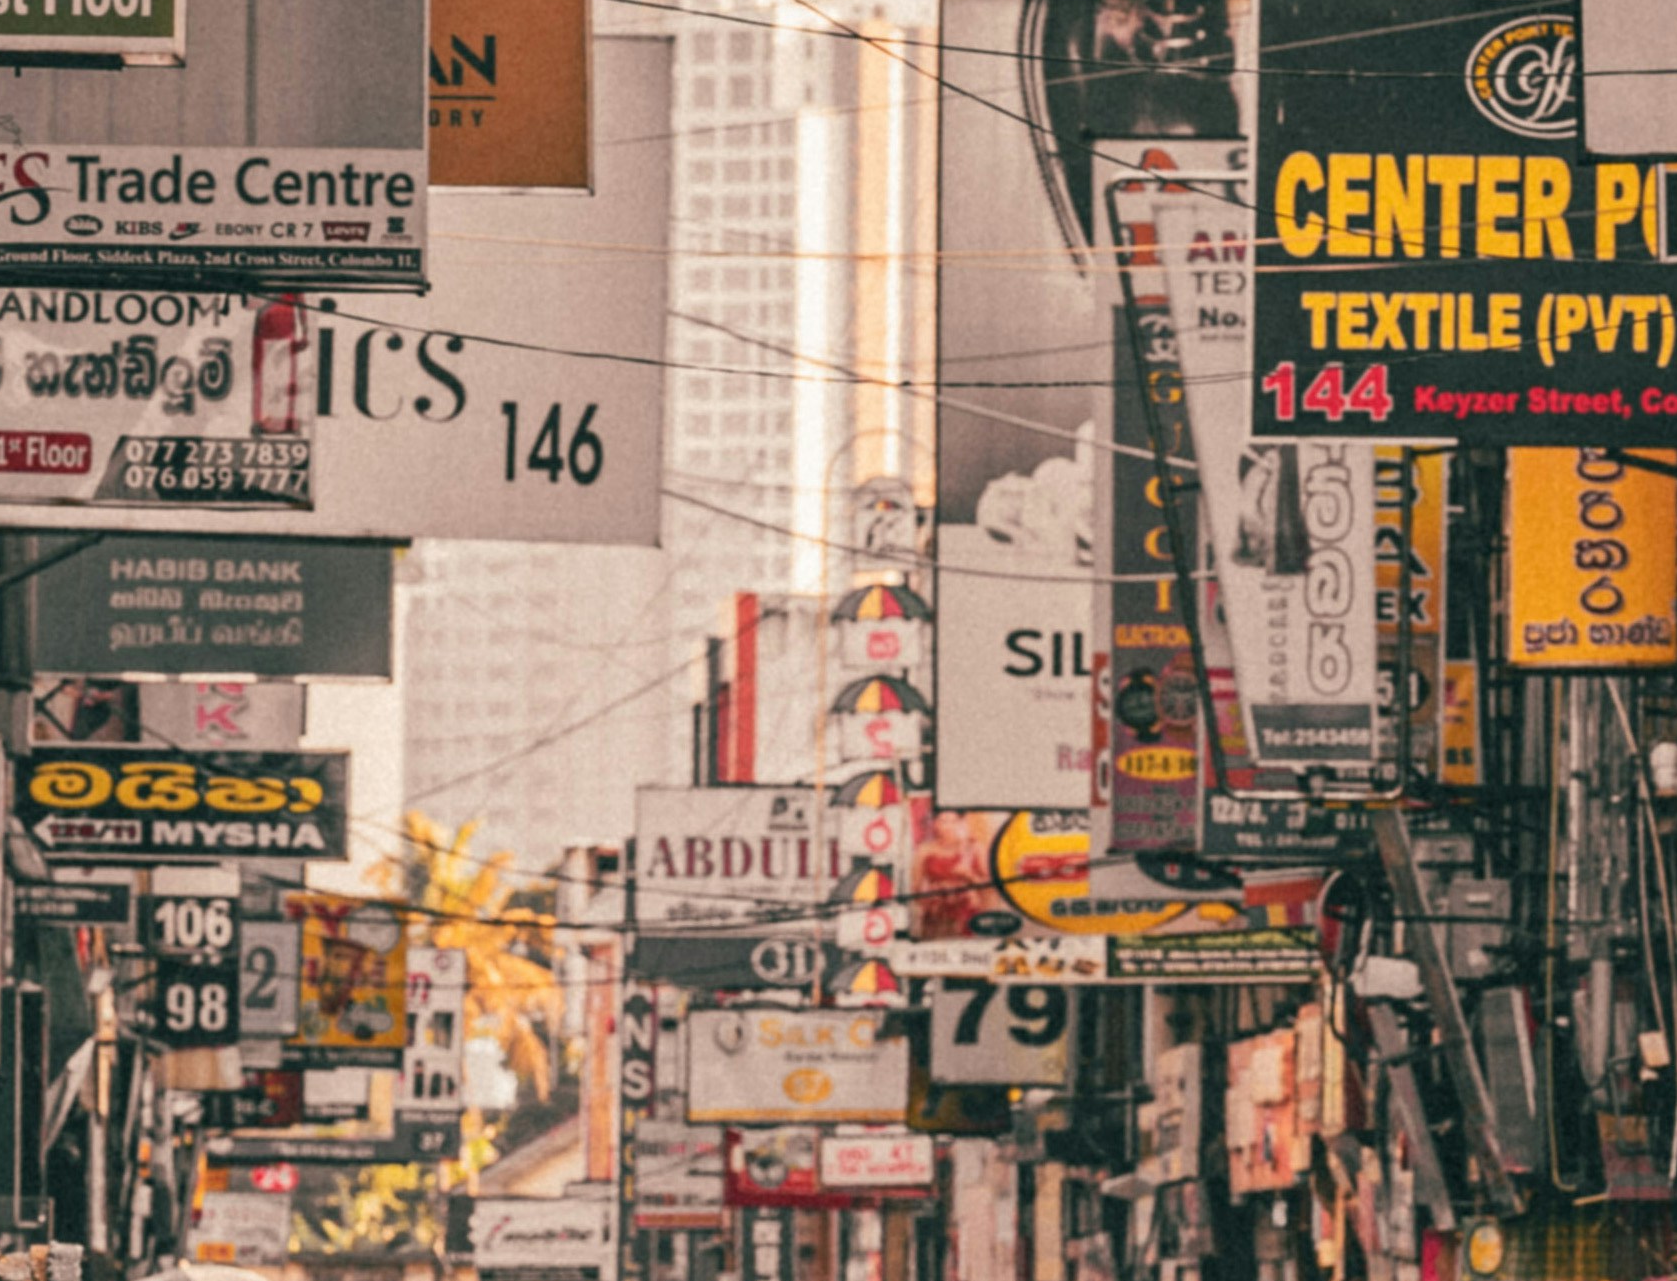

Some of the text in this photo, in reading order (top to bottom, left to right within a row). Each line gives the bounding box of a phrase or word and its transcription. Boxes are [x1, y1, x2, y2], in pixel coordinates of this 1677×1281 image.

[67, 154, 216, 205] Trade
[236, 156, 415, 208] Centre
[1274, 151, 1575, 260] CENTER
[115, 221, 163, 237] KIBS
[215, 223, 263, 238] EBONY
[270, 222, 298, 239] CR
[204, 251, 231, 266] 2nd
[234, 252, 277, 267] Cross
[328, 253, 393, 268] Colombo
[1300, 292, 1521, 352] TEXTILE
[1537, 293, 1677, 369] (PVT)
[1262, 362, 1393, 421] 144
[1526, 386, 1633, 420] Street,
[25, 437, 90, 470] Floor
[125, 439, 308, 465] 077 273 7839
[500, 400, 605, 486] 146
[125, 466, 175, 489] 076
[242, 467, 308, 492] 7777
[109, 558, 302, 584] HABIB BANK
[151, 821, 325, 850] MYSHA
[155, 900, 233, 948] 106
[244, 946, 278, 1009] 2
[165, 983, 229, 1032] 98
[940, 982, 1071, 1047] 79
